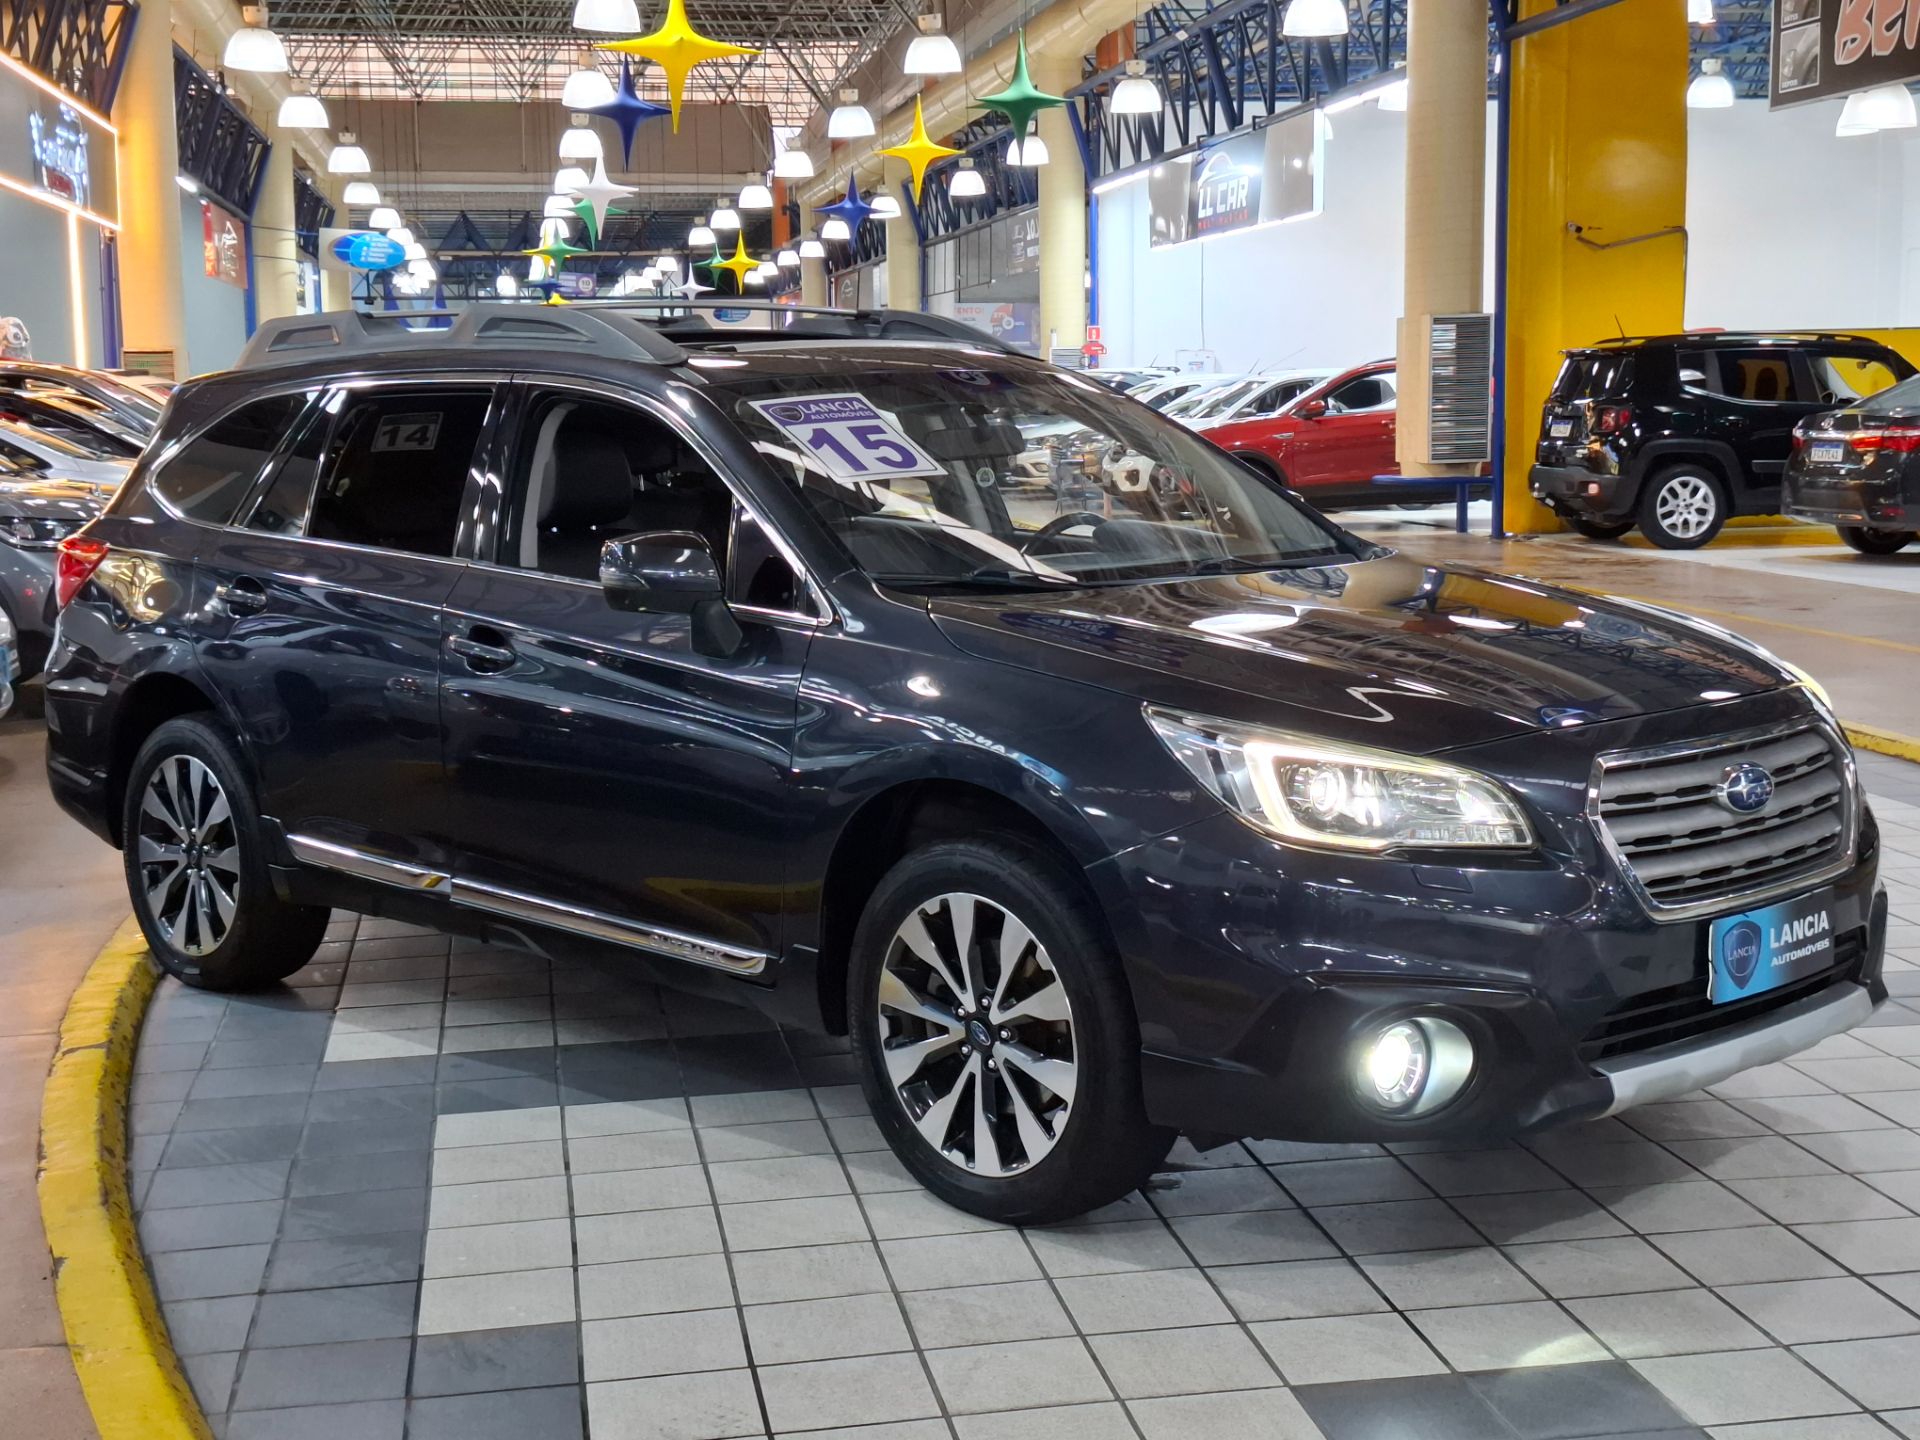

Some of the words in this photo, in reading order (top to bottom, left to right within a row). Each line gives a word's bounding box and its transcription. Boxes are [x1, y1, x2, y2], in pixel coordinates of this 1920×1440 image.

[1217, 176, 1249, 211] CAR
[798, 400, 868, 414] LANCIA
[811, 409, 875, 420] AUTOMÓVEIS
[382, 424, 430, 448] 14
[807, 424, 918, 472] 15
[1770, 911, 1829, 949] LANCIA
[1771, 937, 1829, 968] AUTOMÓVEIS
